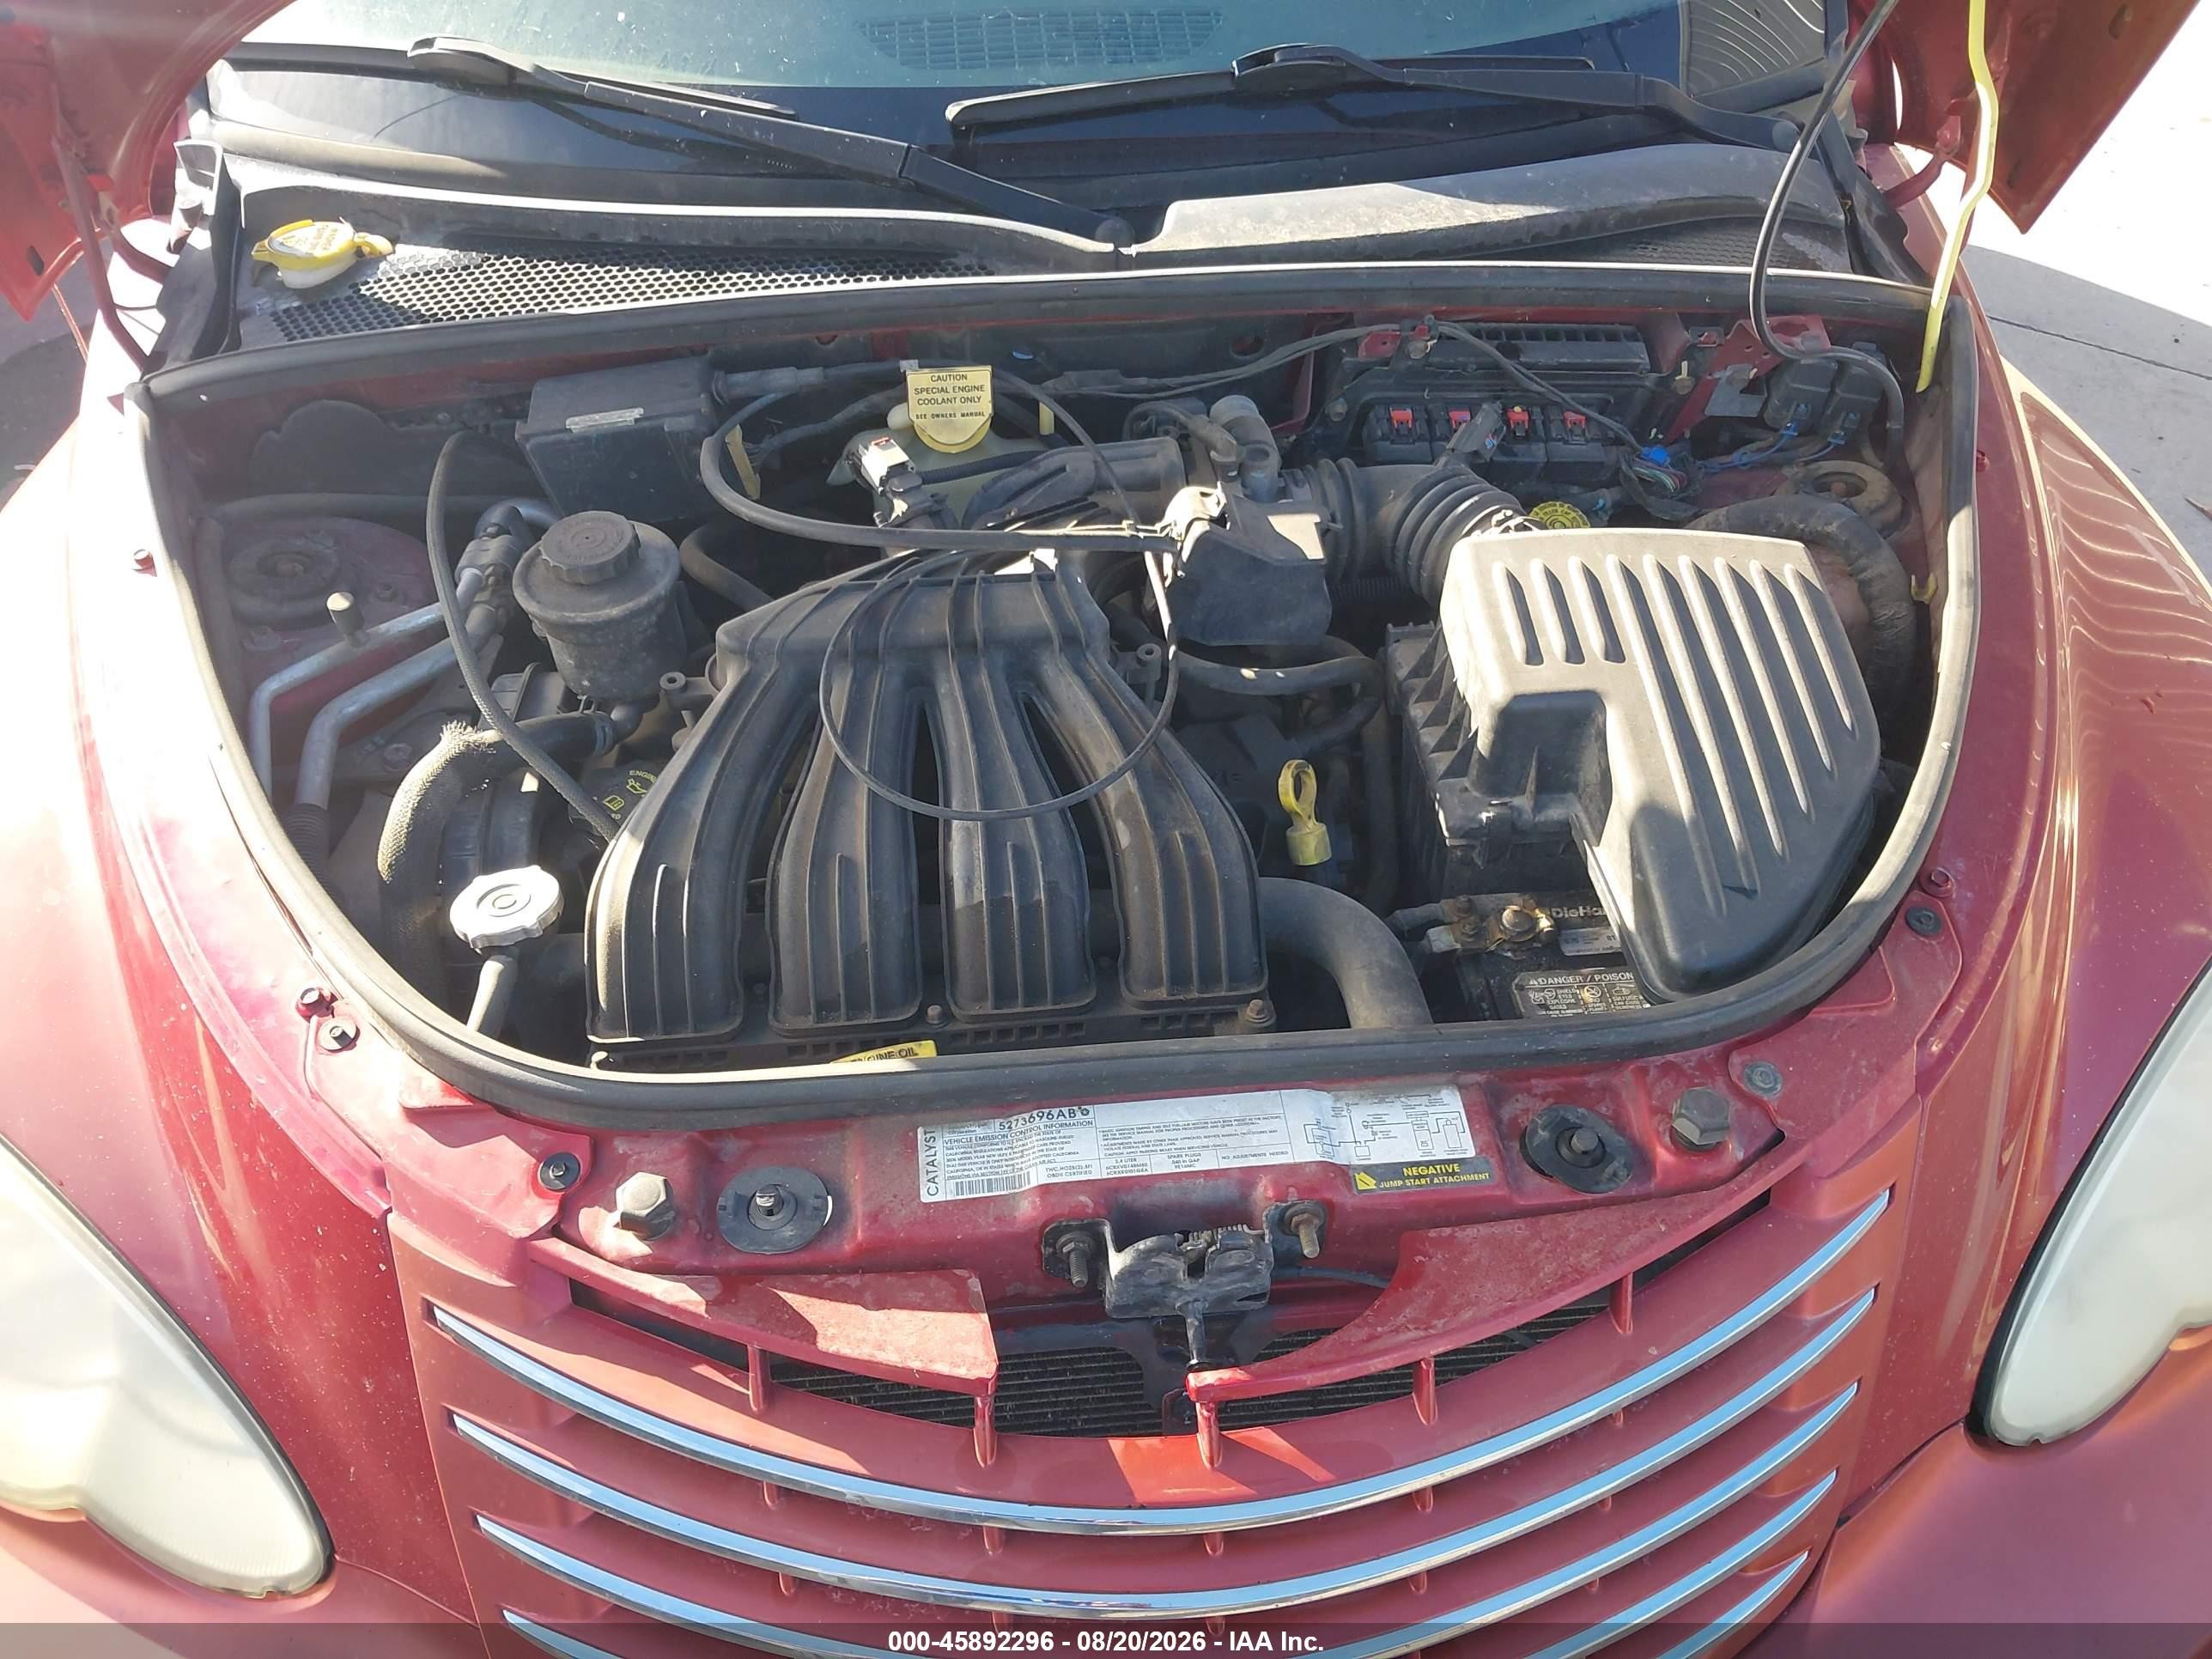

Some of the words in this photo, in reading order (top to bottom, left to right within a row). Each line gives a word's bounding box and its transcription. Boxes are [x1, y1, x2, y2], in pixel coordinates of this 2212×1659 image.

[931, 374, 968, 382] CAUTION
[914, 386, 950, 395] SPECIAL
[952, 385, 986, 393] ENGINE
[917, 397, 957, 406] COOLANT
[960, 395, 981, 404] ONLY
[629, 770, 658, 783] ENGIN
[1540, 975, 1584, 985] DANGER
[1594, 972, 1634, 981] POISON
[898, 1047, 919, 1057] OIL
[999, 1108, 1077, 1130] 5273696AB
[975, 1133, 1008, 1142] EMISSION
[1010, 1125, 1042, 1138] CONTROL
[1043, 1120, 1093, 1130] INFORMATION
[925, 1129, 939, 1196] CATALYST
[1402, 1163, 1461, 1176] NEGATIVE
[1379, 1180, 1403, 1188] JUMP
[1405, 1177, 1431, 1186] START
[1433, 1173, 1490, 1184] ATTACHMENT
